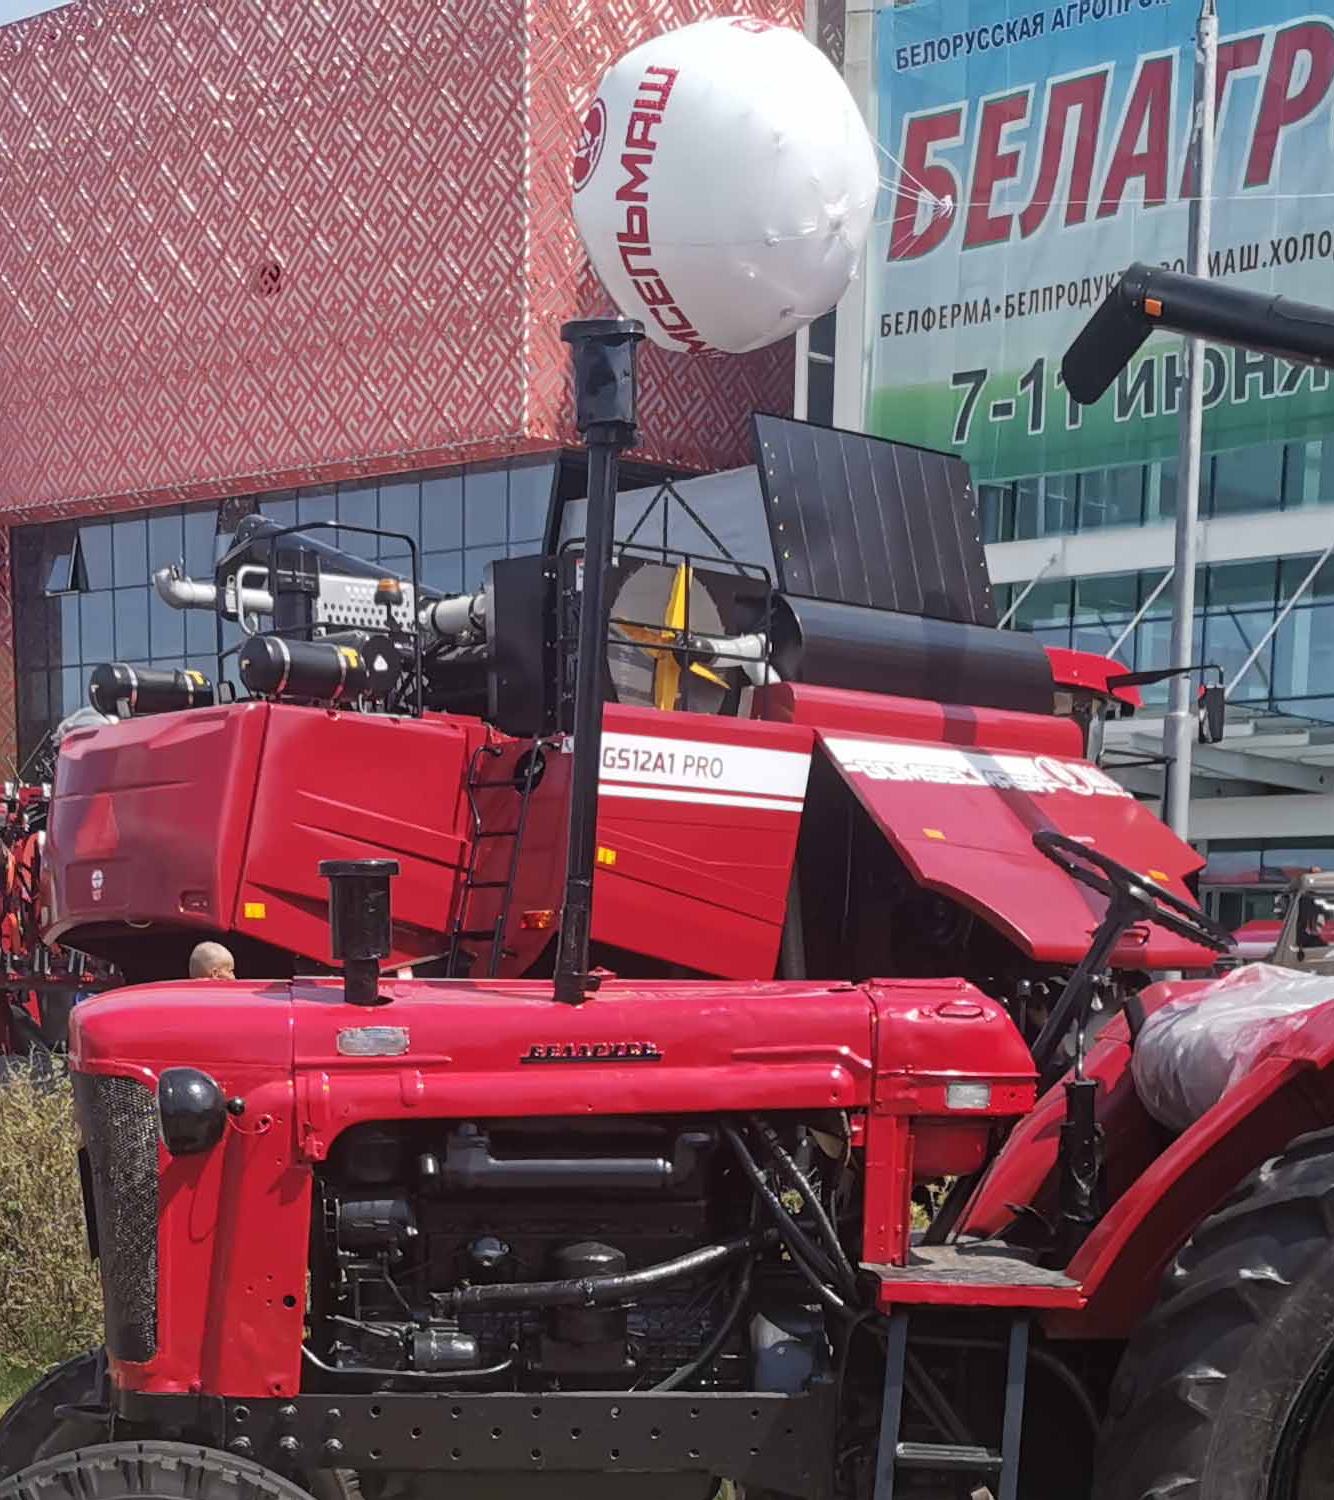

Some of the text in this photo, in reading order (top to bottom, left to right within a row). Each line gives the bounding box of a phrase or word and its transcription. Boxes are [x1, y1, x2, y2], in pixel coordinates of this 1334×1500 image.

[895, 11, 1045, 71] БЕЛОРУССКАЯ
[602, 746, 724, 780] GS12A1 PRO
